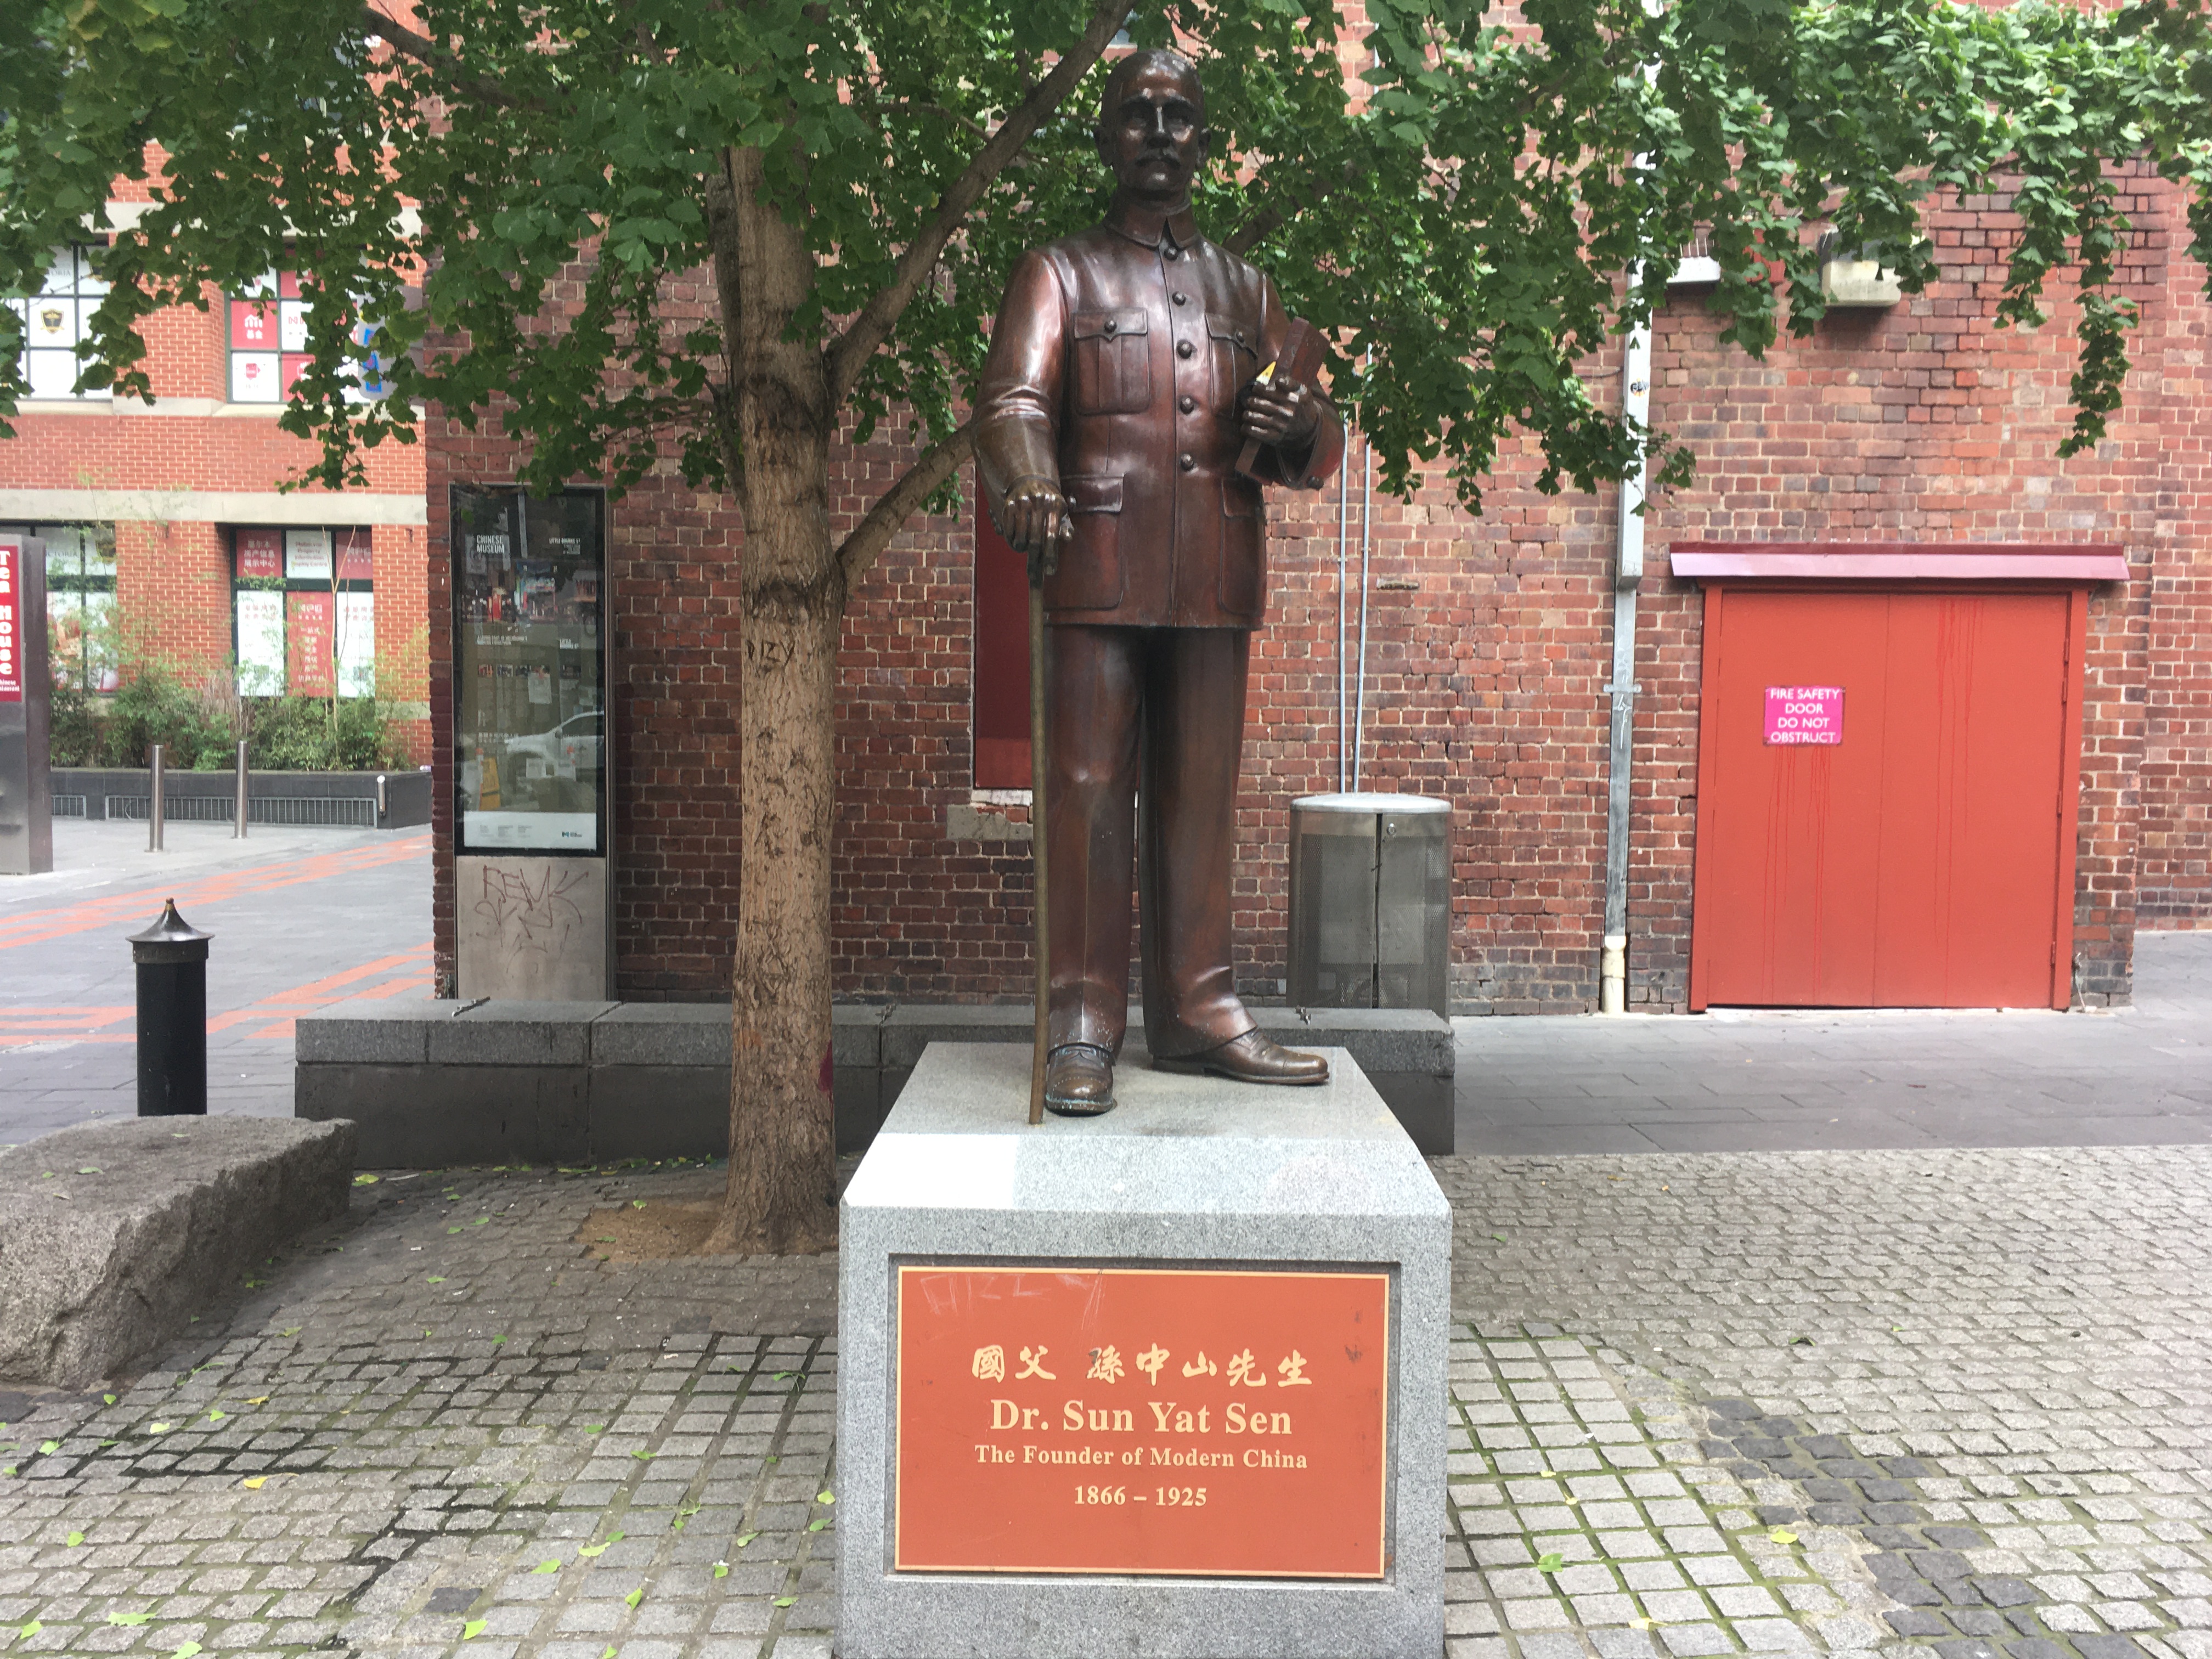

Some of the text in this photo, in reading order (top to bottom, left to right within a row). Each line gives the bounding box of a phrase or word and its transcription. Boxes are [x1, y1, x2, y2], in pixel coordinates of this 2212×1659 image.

[1770, 688, 1839, 700] FIRE SAFETY
[1785, 703, 1824, 714] DOOR
[1778, 717, 1830, 729] DO NOT
[1770, 731, 1836, 743] OBSTRUCT
[972, 1342, 1312, 1387] 國父 孫中山先生
[990, 1400, 1292, 1435] Dr. Sun Yat Sen
[974, 1444, 1307, 1469] The Founder of Modern China
[1075, 1485, 1126, 1505] 1866
[1156, 1487, 1207, 1506] 1925
